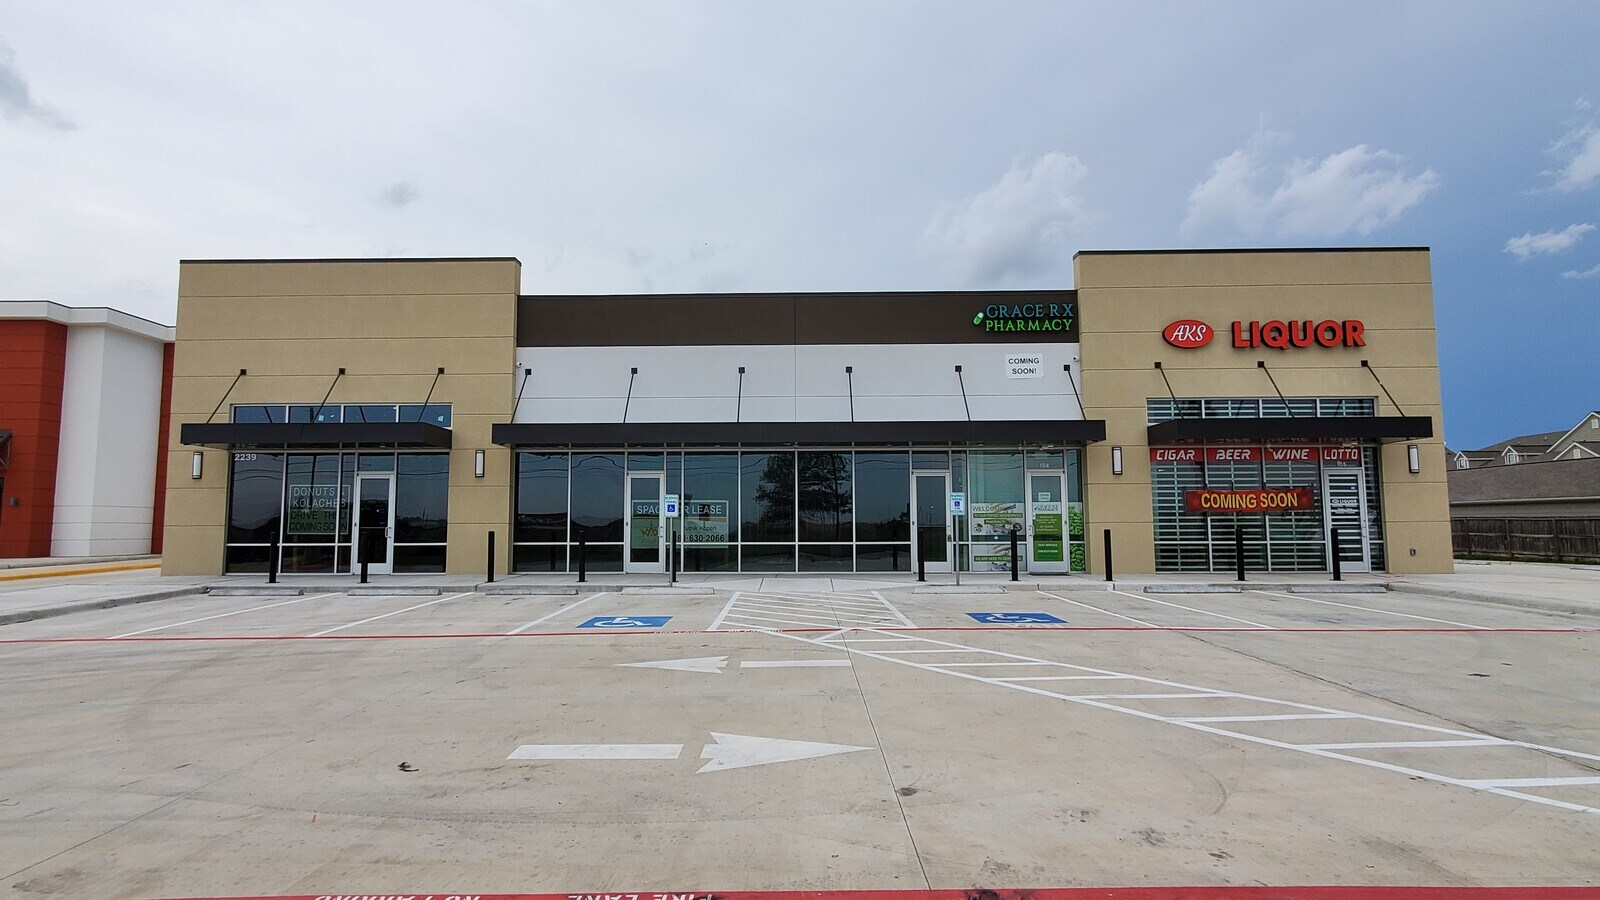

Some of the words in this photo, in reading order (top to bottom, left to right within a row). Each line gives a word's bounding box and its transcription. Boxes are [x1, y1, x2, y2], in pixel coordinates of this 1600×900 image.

[986, 304, 1044, 318] GRACE
[1049, 303, 1074, 317] RX
[985, 319, 1073, 331] PHARMACY
[1170, 324, 1207, 342] AKS
[1232, 320, 1366, 351] LIQUOR
[1008, 357, 1040, 365] COMING
[1011, 367, 1037, 375] SOON!
[1156, 449, 1196, 460] CIGAR
[1215, 449, 1250, 460] BEER
[1272, 448, 1310, 460] WINE
[1323, 449, 1358, 460] LOTTO
[293, 487, 335, 496] DONUTS
[1201, 493, 1257, 509] COMING
[1260, 492, 1298, 508] SOON
[291, 511, 318, 519] DRIVE
[323, 511, 347, 519] THU
[636, 505, 661, 514] SPAC
[691, 505, 722, 514] LEASE
